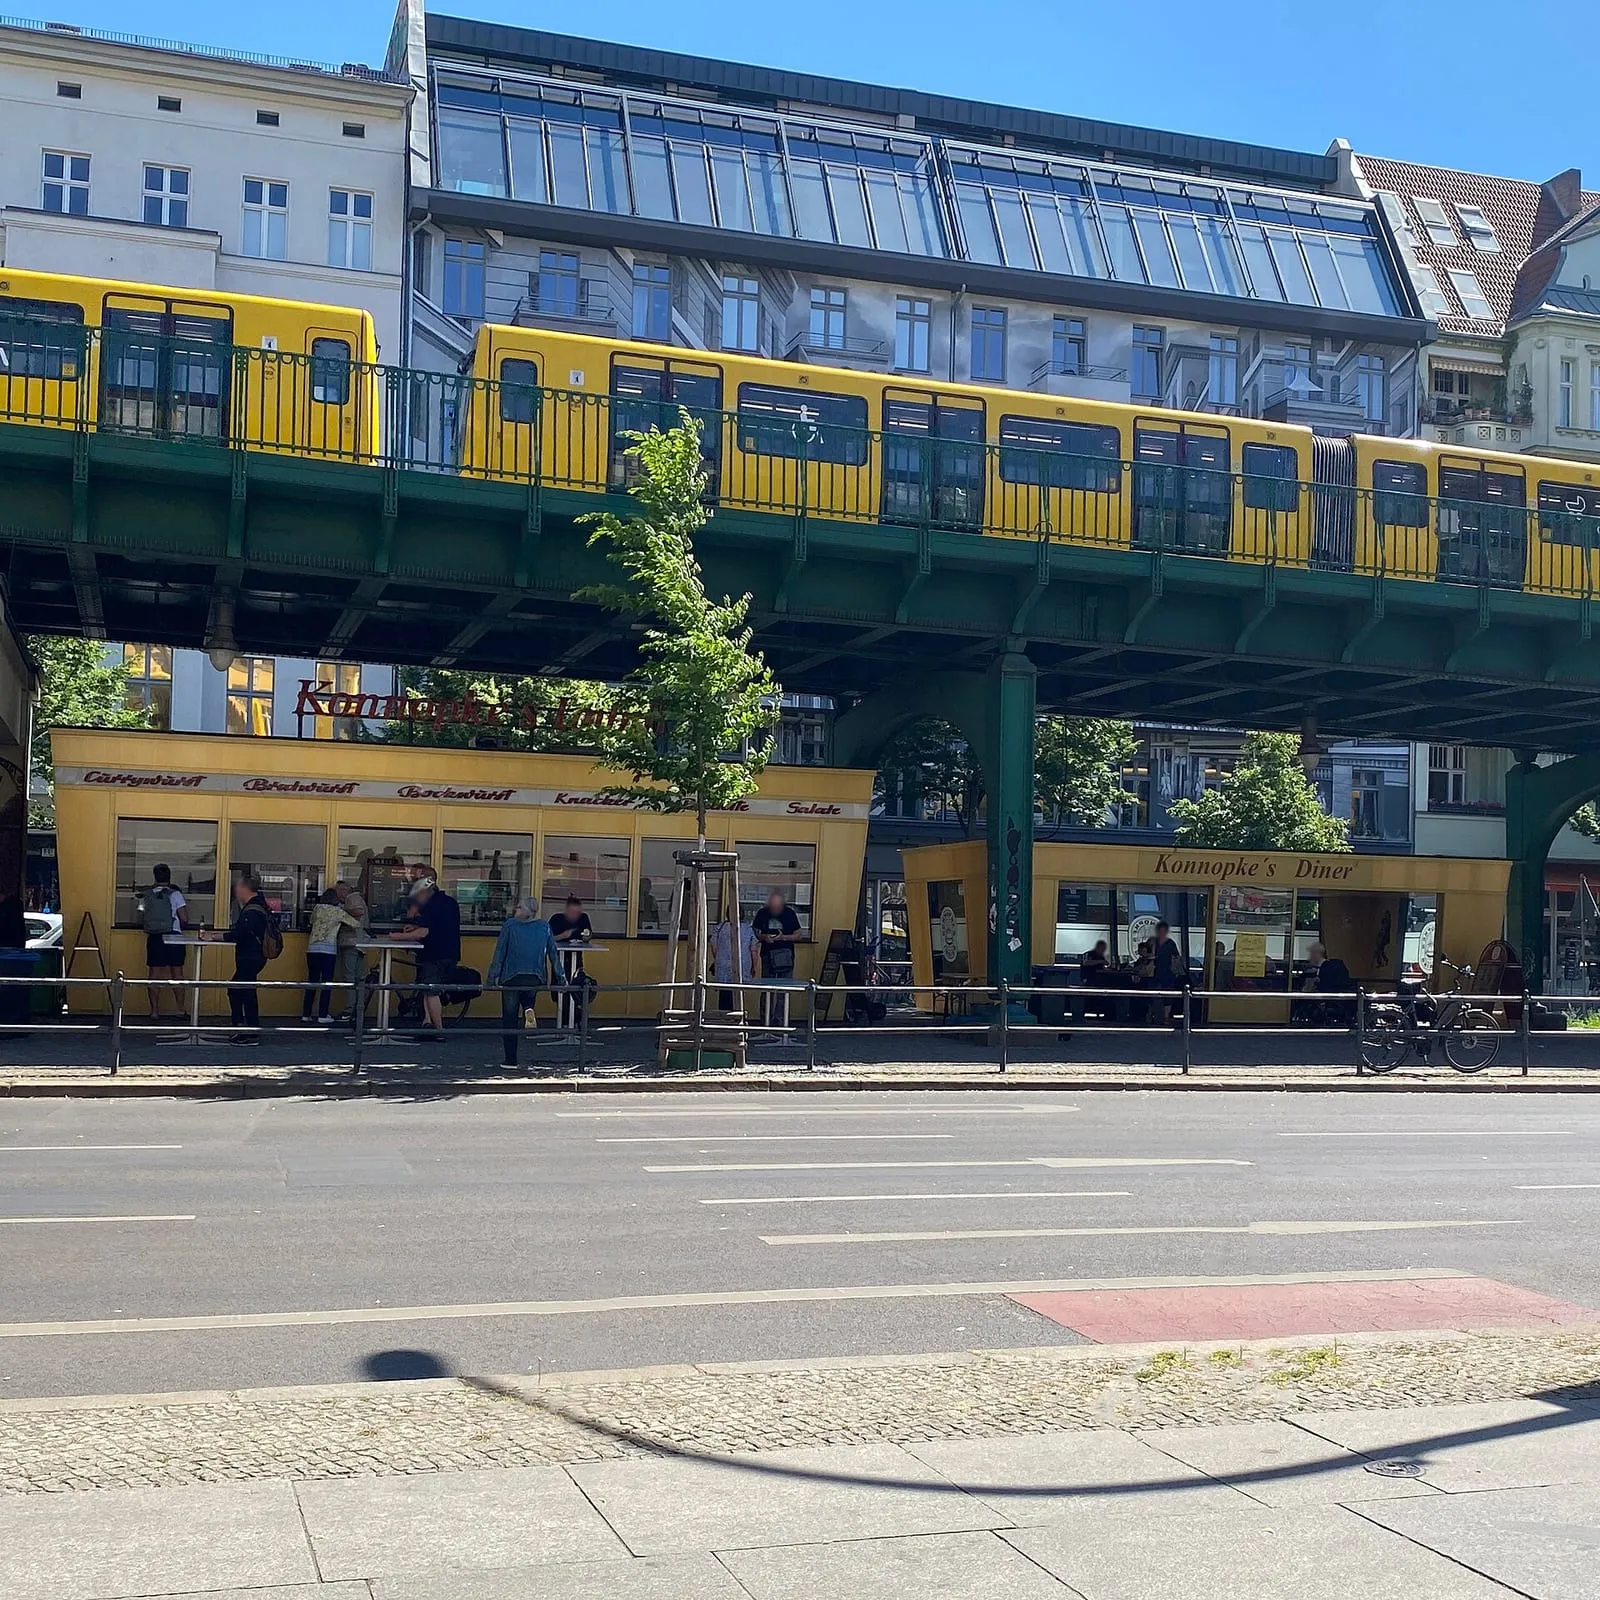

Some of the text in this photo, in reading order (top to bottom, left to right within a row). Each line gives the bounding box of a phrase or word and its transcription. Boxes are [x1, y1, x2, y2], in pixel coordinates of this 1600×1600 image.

[84, 771, 207, 787] Currywurst
[243, 778, 360, 794] Bratwurst
[398, 785, 516, 801] Bockwurst
[786, 802, 841, 815] Salate
[1154, 854, 1353, 880] Konnopke's Diner
